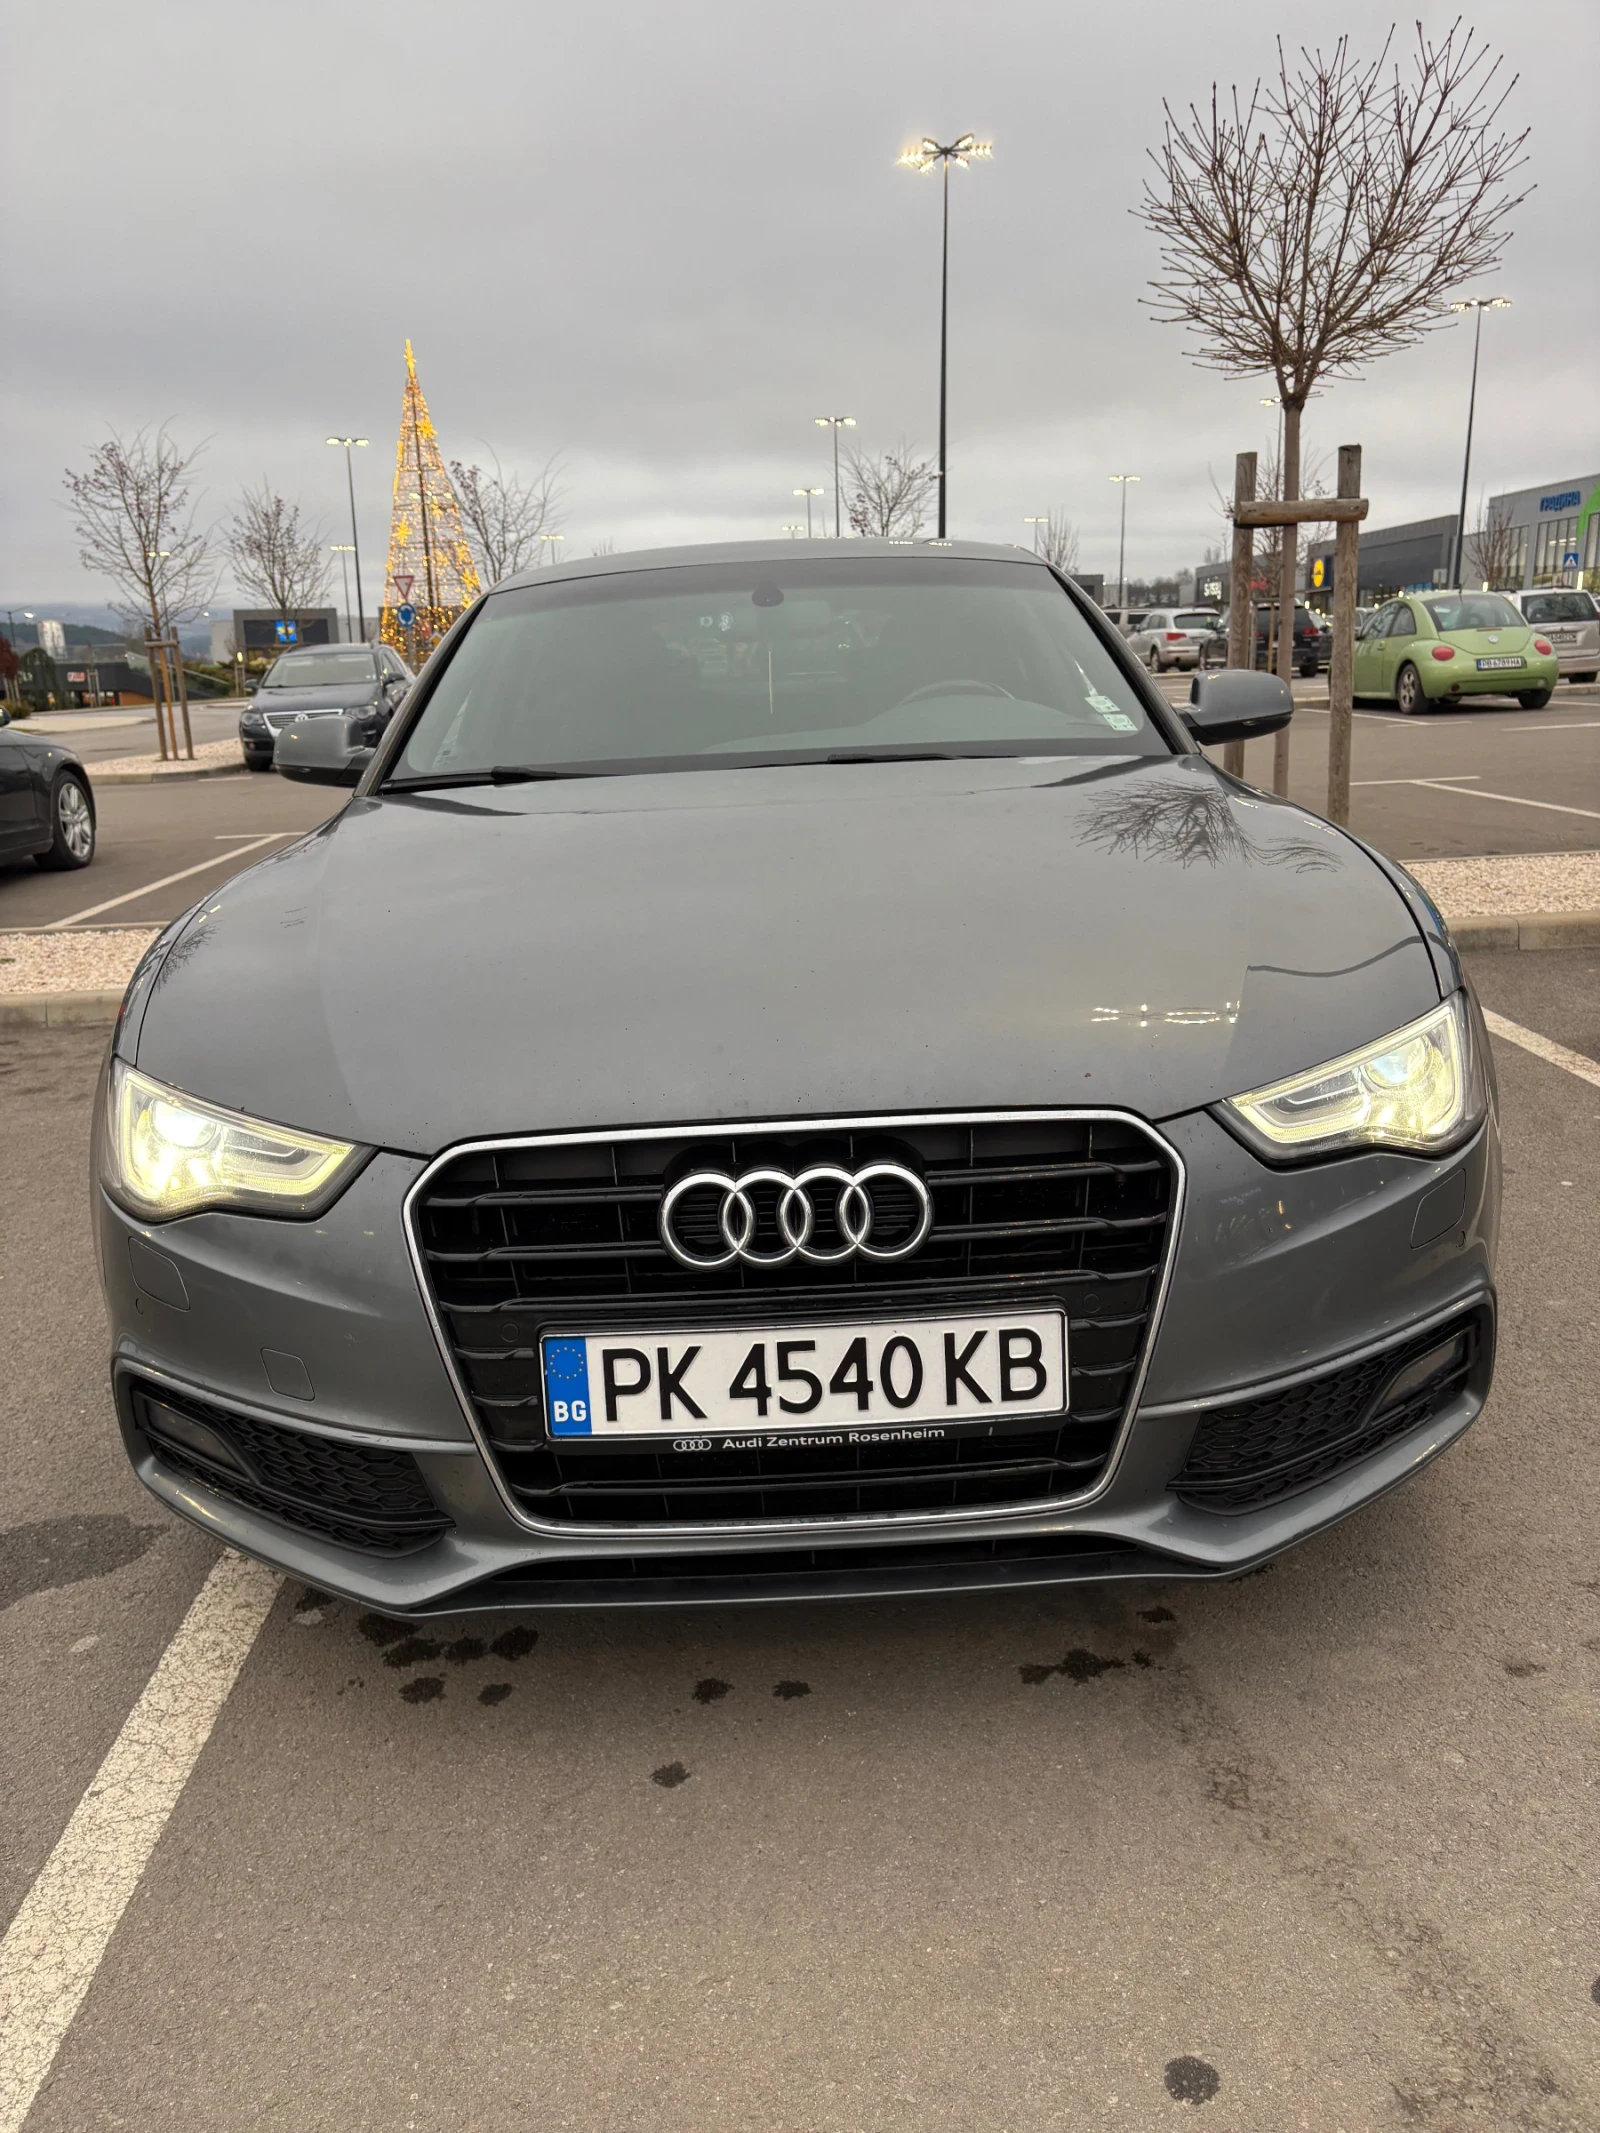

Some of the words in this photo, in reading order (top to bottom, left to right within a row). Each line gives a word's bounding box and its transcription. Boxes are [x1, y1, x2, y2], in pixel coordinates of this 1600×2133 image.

[601, 1345, 708, 1422] PK
[728, 1334, 924, 1417] 4540
[943, 1327, 1048, 1407] KB
[553, 1399, 588, 1423] BG
[722, 1436, 763, 1450] Audi
[766, 1433, 844, 1448] Zentrum
[848, 1427, 945, 1443] Rosenheim
